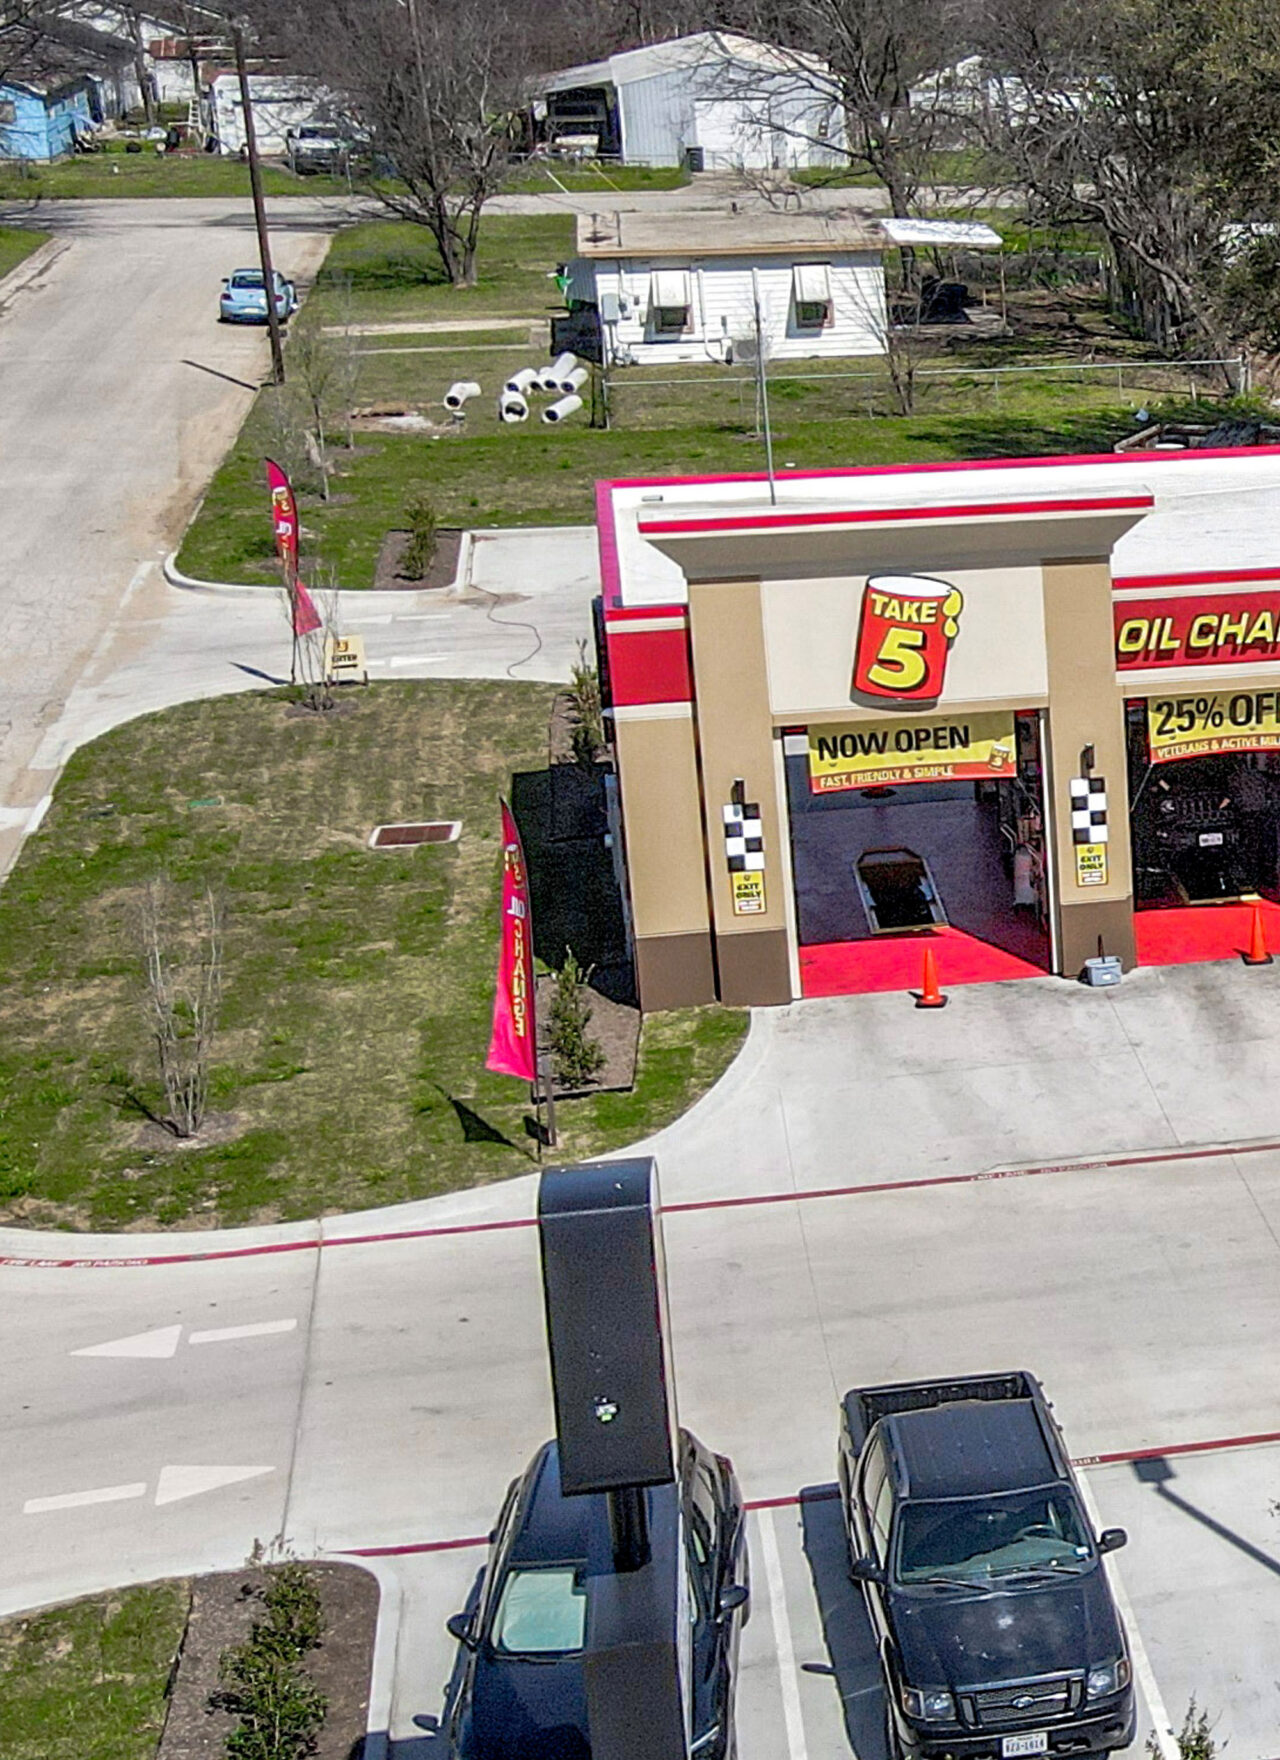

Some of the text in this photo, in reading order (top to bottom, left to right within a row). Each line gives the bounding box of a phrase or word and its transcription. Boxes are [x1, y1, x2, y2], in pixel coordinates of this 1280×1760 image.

[871, 593, 938, 624] TAKE
[1117, 617, 1181, 653] OIL
[867, 626, 927, 690] 5
[1155, 696, 1224, 736] 25%
[817, 725, 970, 761] NOW OPEN
[1157, 741, 1209, 758] VETERANS
[1210, 740, 1219, 750] &
[1221, 736, 1259, 749] ACTIVE
[850, 769, 901, 786] FRIENDLY
[903, 769, 912, 780] &
[913, 765, 954, 778] SIMPLE
[1079, 862, 1104, 871] ONLY
[1080, 855, 1102, 863] EXIT
[736, 890, 762, 899] ONLY
[737, 882, 760, 891] EXIT
